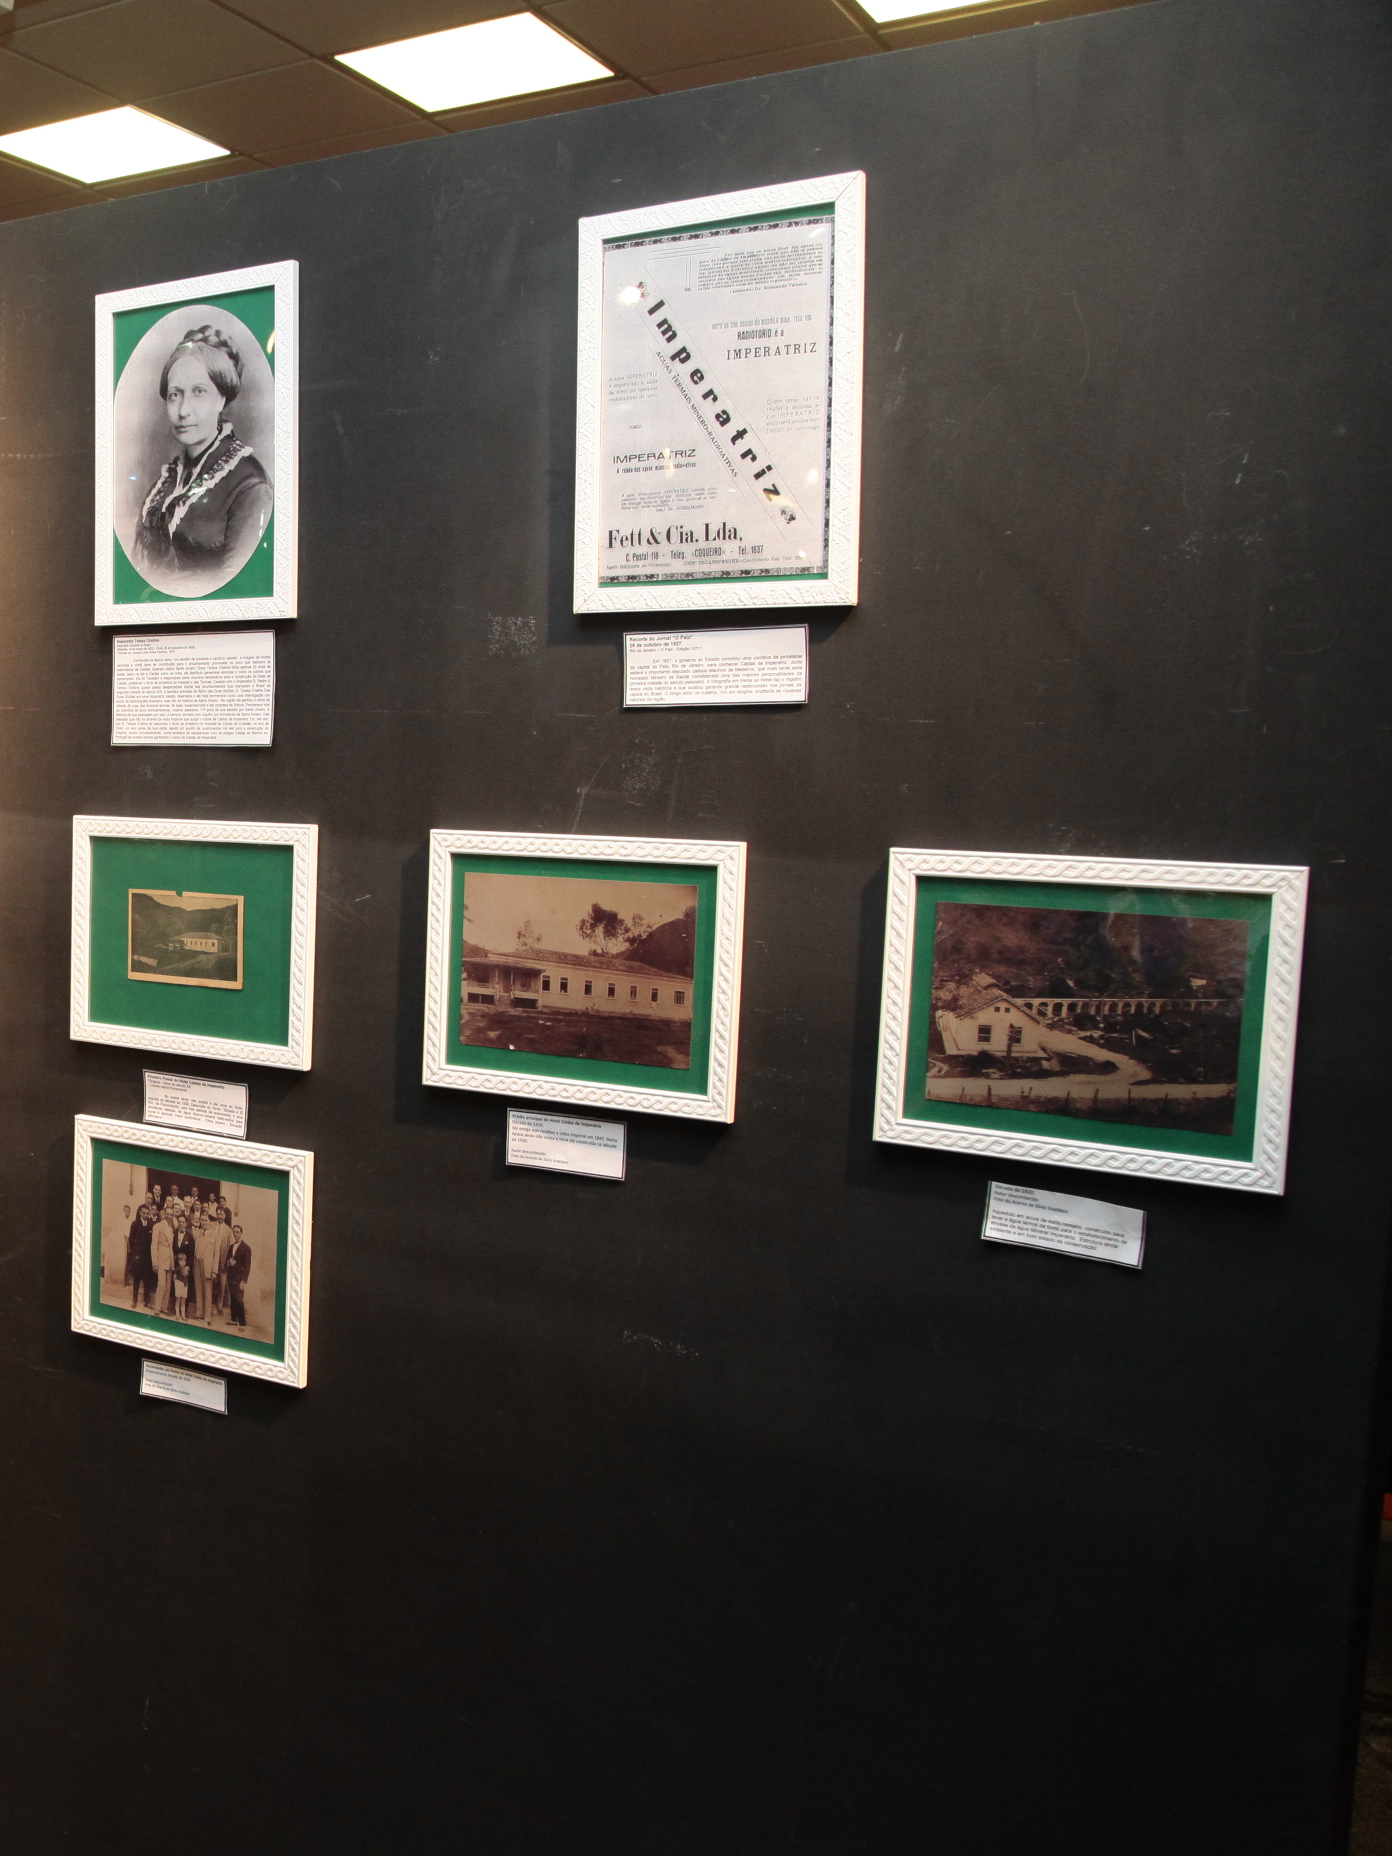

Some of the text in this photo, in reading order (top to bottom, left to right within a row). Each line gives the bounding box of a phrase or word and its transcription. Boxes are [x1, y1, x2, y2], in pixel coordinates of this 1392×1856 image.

[727, 342, 817, 360] IMPERATRIZ
[647, 299, 780, 502] Imperatriz
[607, 527, 643, 549] Fett
[647, 527, 662, 545] &
[666, 524, 699, 545] Cia.
[633, 552, 649, 561] Postal
